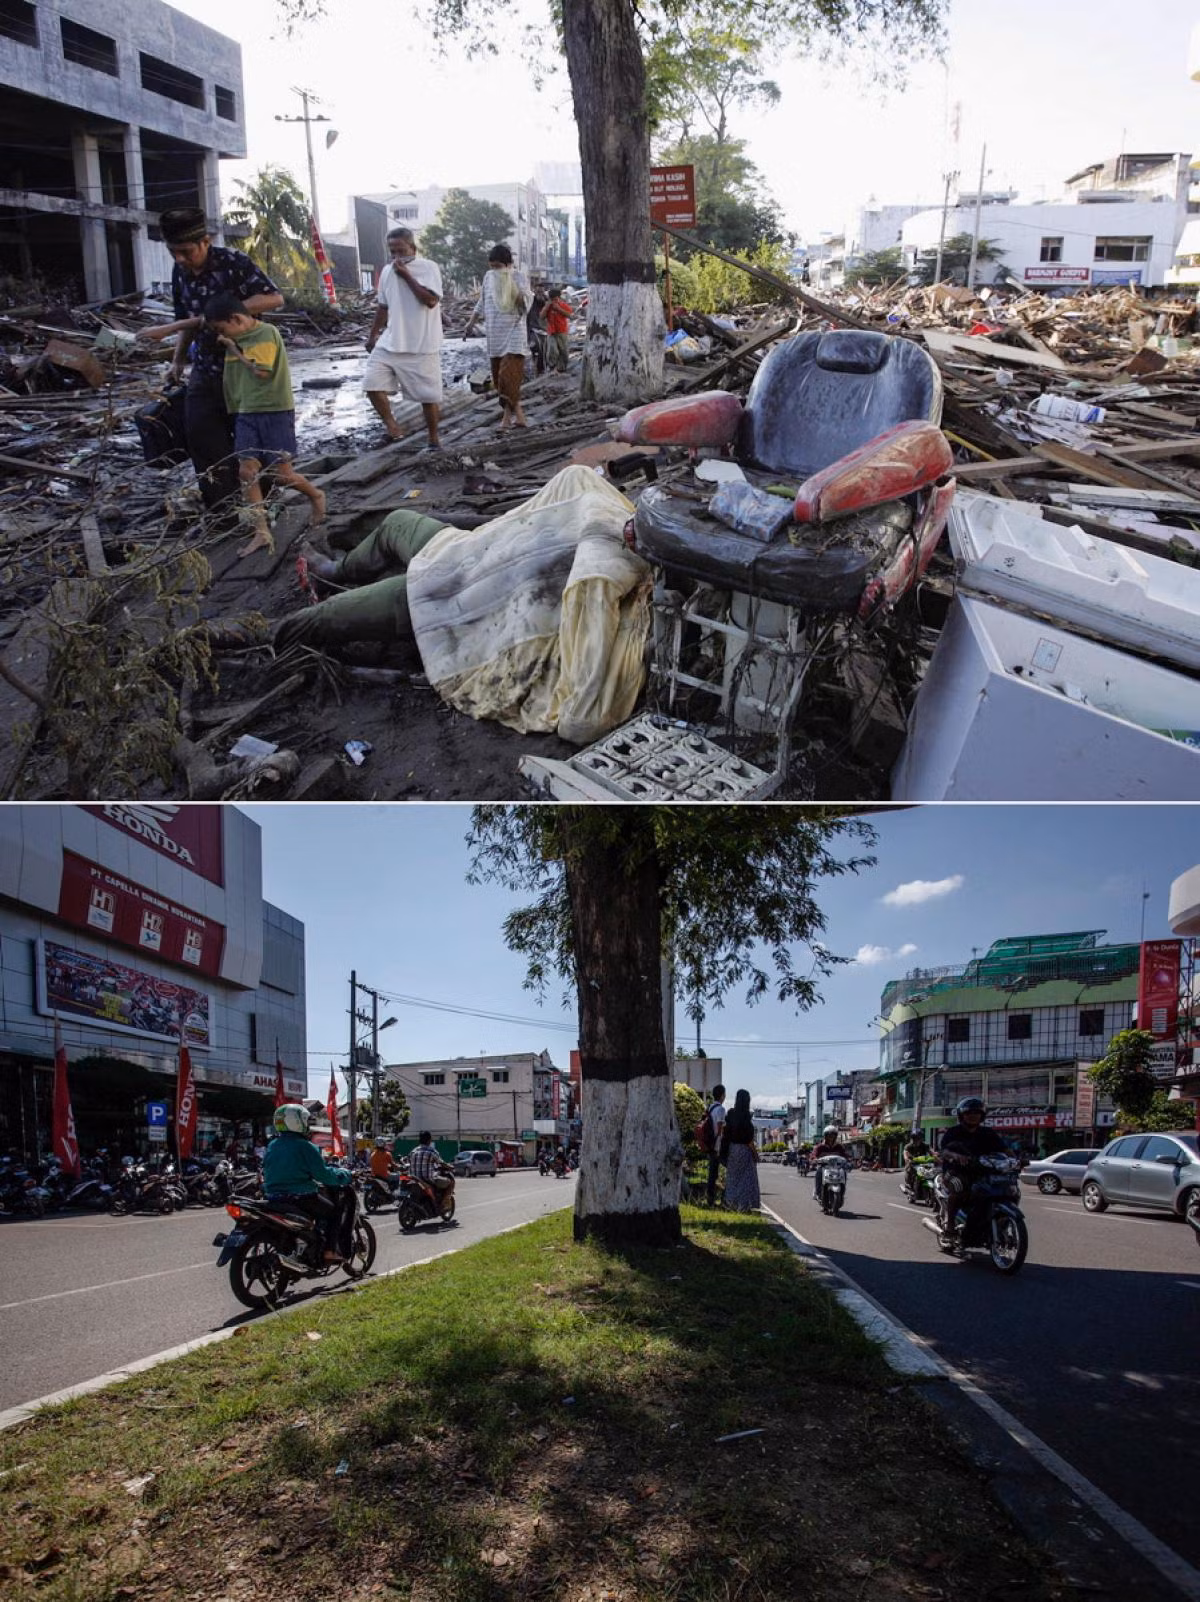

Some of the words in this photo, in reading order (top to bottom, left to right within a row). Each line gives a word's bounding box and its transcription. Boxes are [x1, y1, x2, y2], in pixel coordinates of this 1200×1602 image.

[103, 804, 195, 866] HONDA
[104, 874, 140, 898] CAPELLA
[151, 1106, 165, 1121] P
[983, 1115, 1049, 1127] SCOUNT
